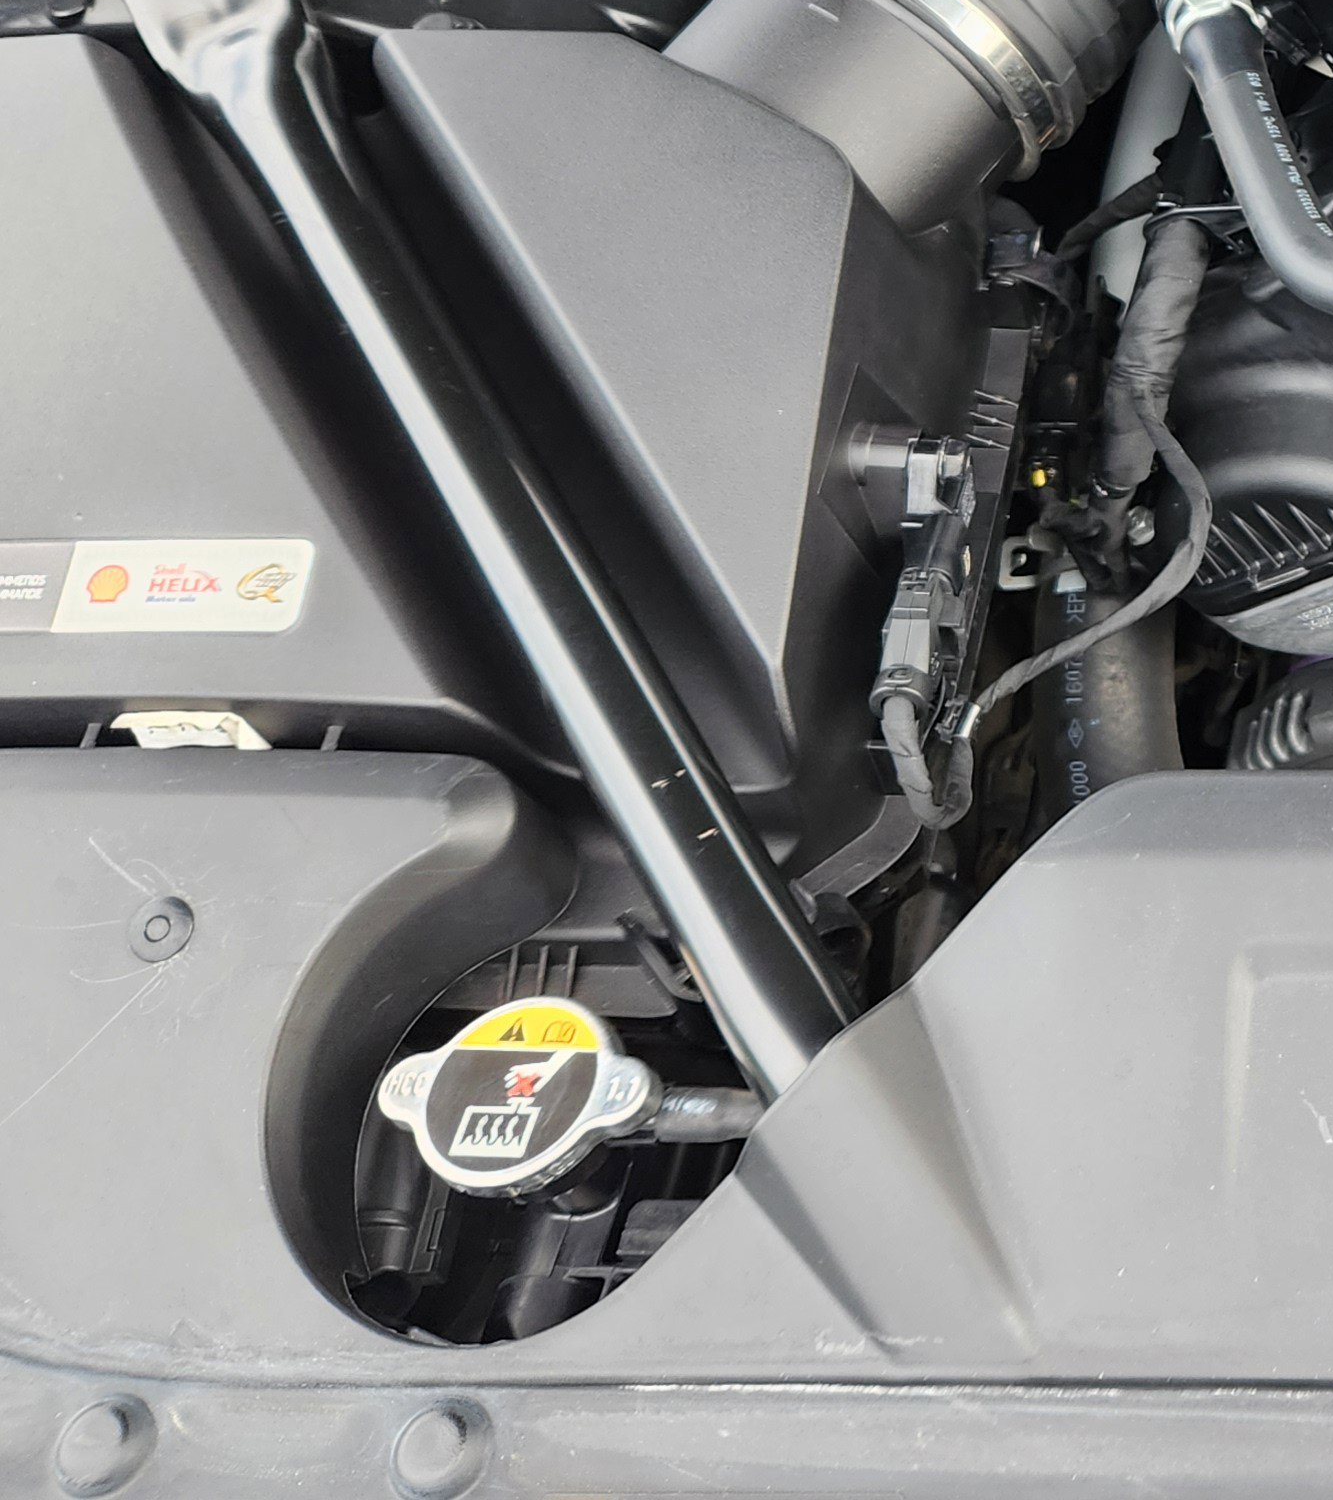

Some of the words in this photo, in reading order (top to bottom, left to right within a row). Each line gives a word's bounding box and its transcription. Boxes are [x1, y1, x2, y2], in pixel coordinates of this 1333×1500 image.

[147, 577, 220, 593] HELIX
[385, 1071, 428, 1096] HCC
[606, 1075, 642, 1101] 1.1
